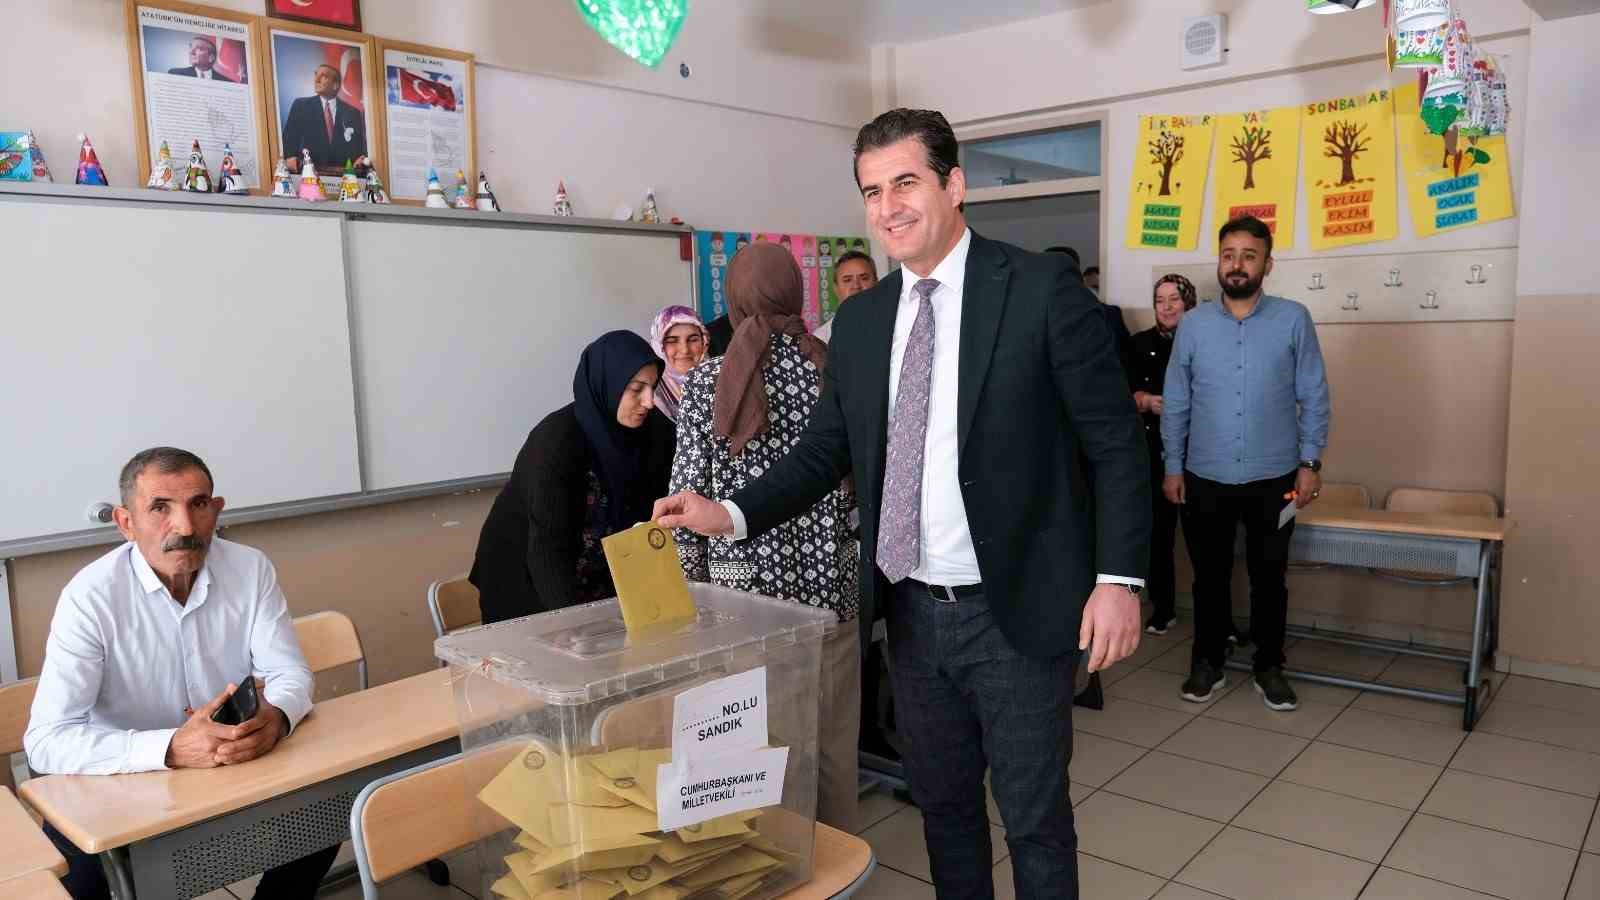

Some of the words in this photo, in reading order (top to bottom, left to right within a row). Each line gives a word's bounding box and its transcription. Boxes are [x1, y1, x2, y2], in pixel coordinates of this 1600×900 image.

[722, 696, 758, 716] NO.LU
[698, 717, 742, 741] SANDIK
[680, 774, 753, 796] CUMHURBAŞKANI
[755, 771, 767, 781] VE
